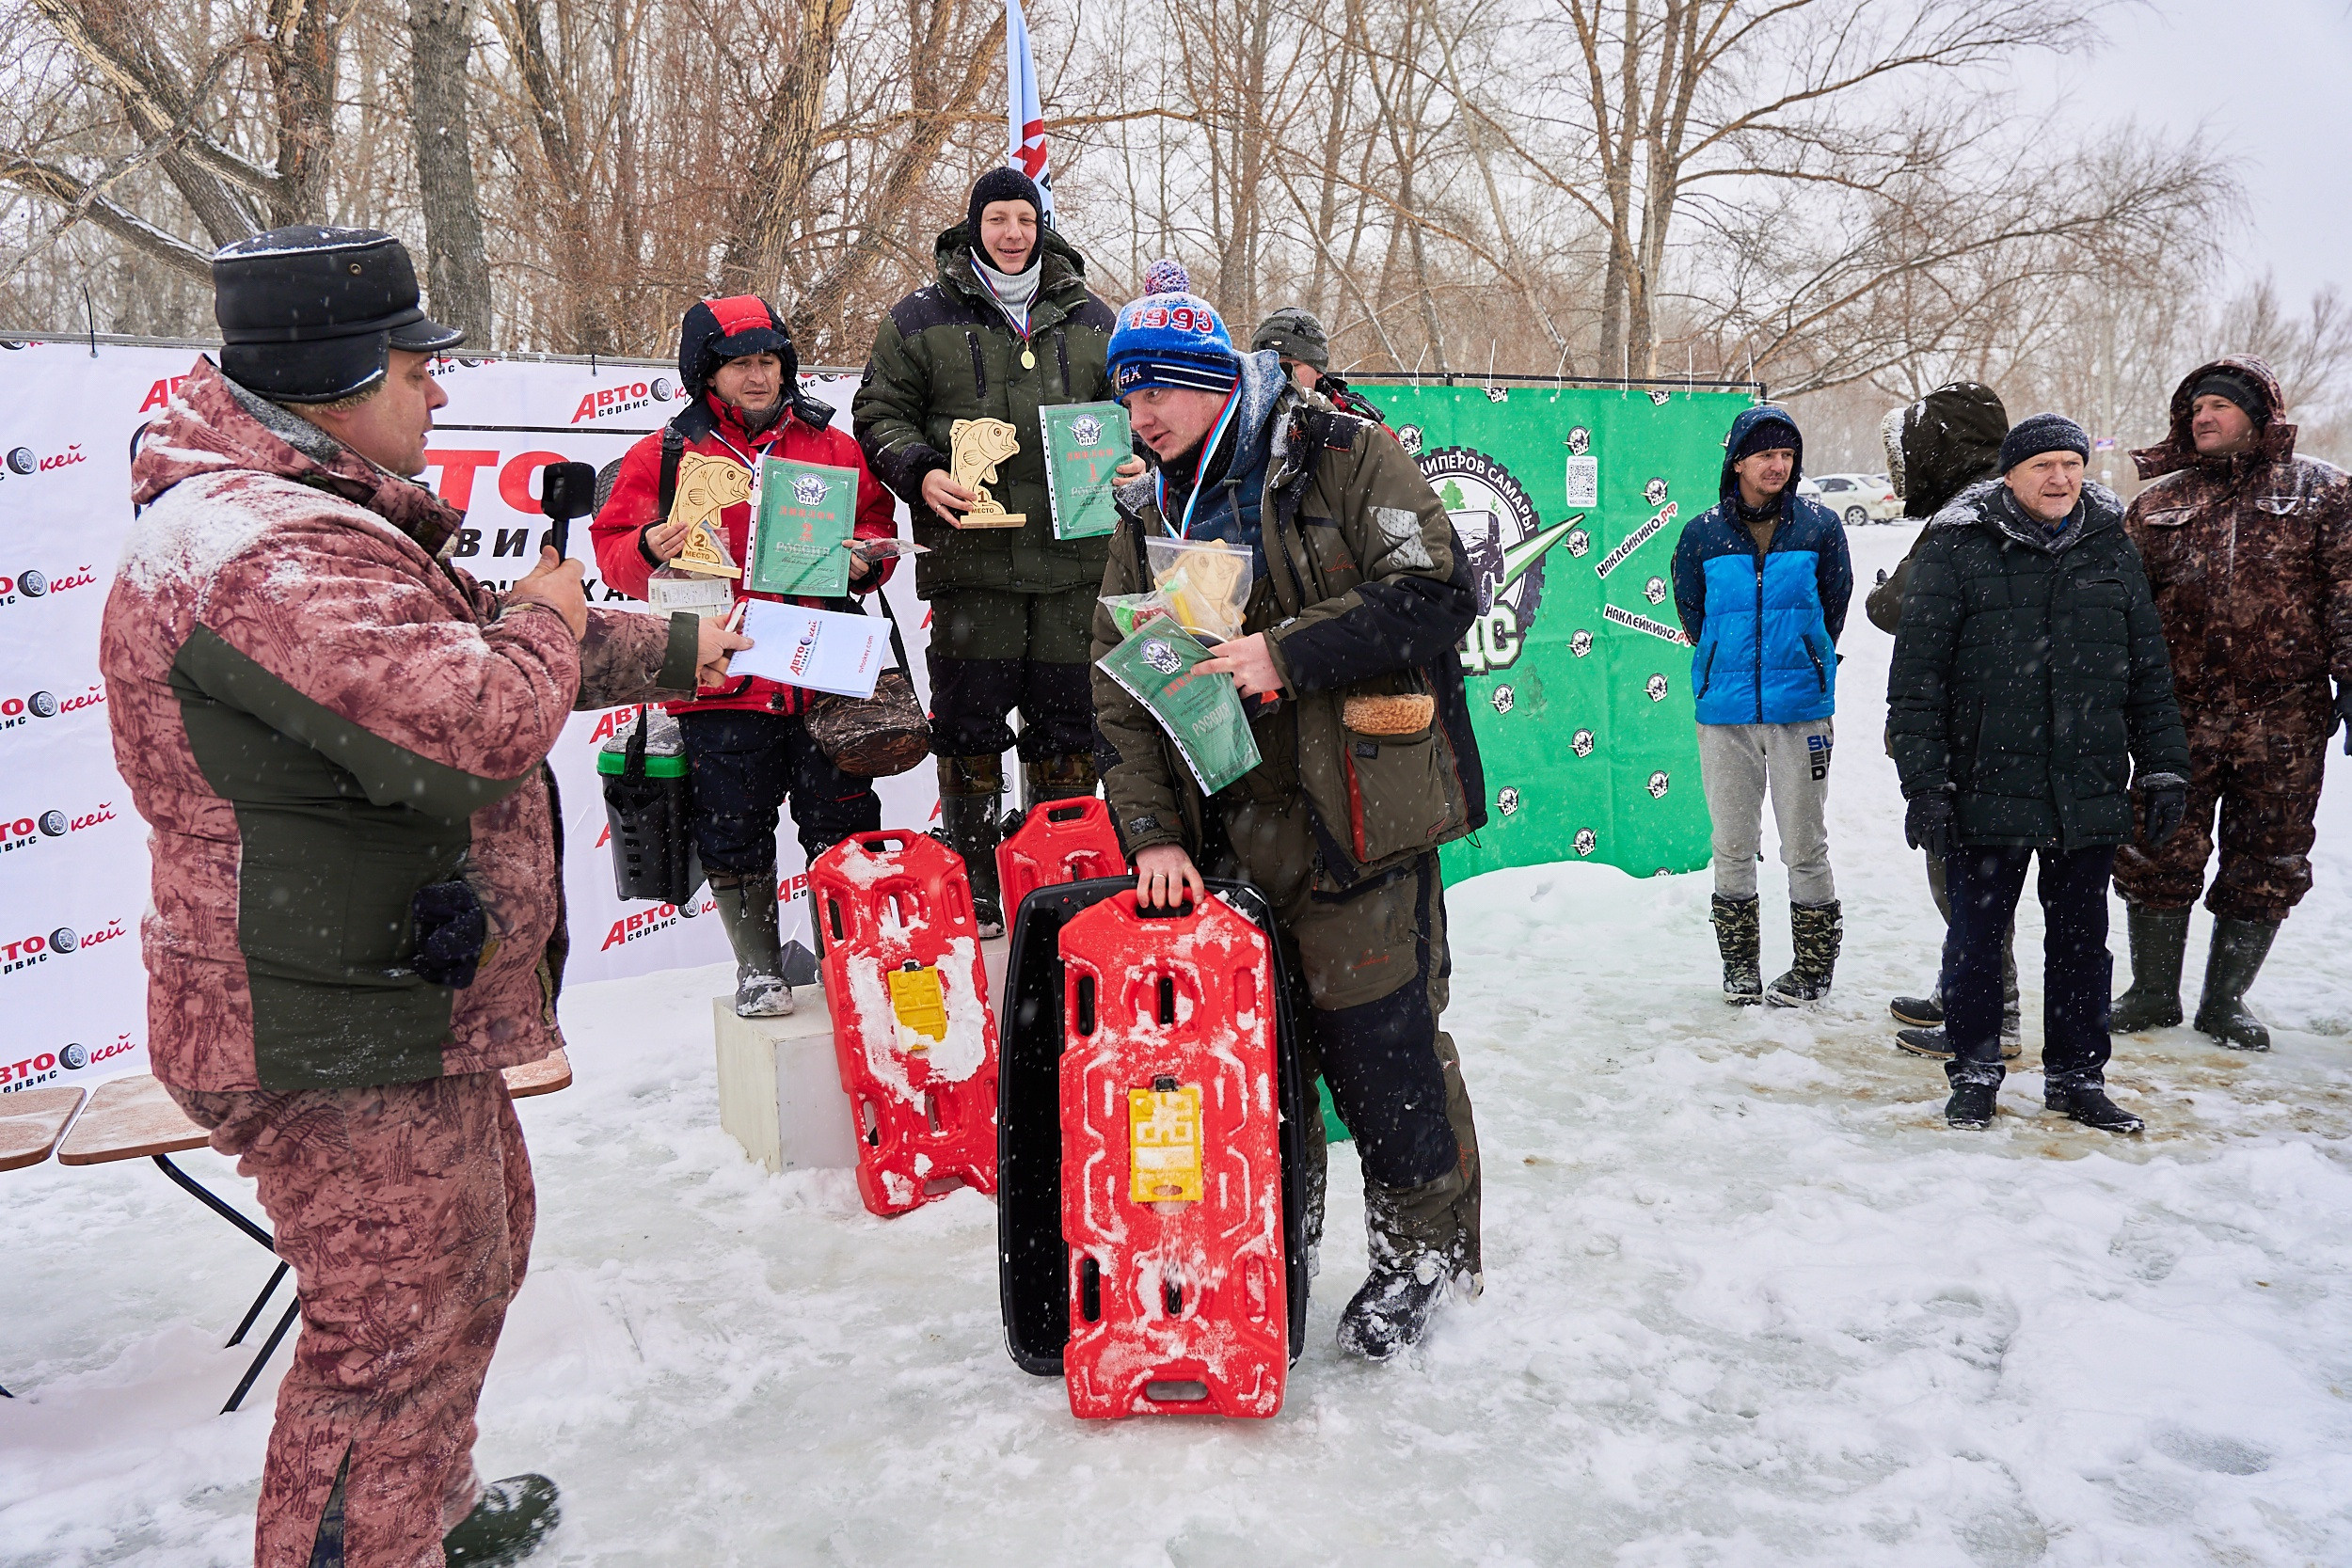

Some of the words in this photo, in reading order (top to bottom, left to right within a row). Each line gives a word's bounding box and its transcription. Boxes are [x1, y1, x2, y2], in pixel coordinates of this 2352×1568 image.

[570, 382, 647, 424] АВТО
[598, 399, 649, 417] сервис
[1079, 436, 1097, 446] СДС
[799, 495, 819, 505] СДС
[977, 490, 988, 503] 1
[1487, 467, 1535, 531] САМАРЫ
[694, 533, 705, 547] 2
[802, 522, 813, 537] 2
[685, 550, 710, 560] МЕСТО
[790, 646, 805, 676] АВТО
[1161, 657, 1183, 675] СДС
[72, 801, 117, 832] кей
[81, 918, 126, 948] кей
[600, 903, 675, 951] АВТО
[628, 917, 676, 942] сервис
[91, 1033, 135, 1064] кей
